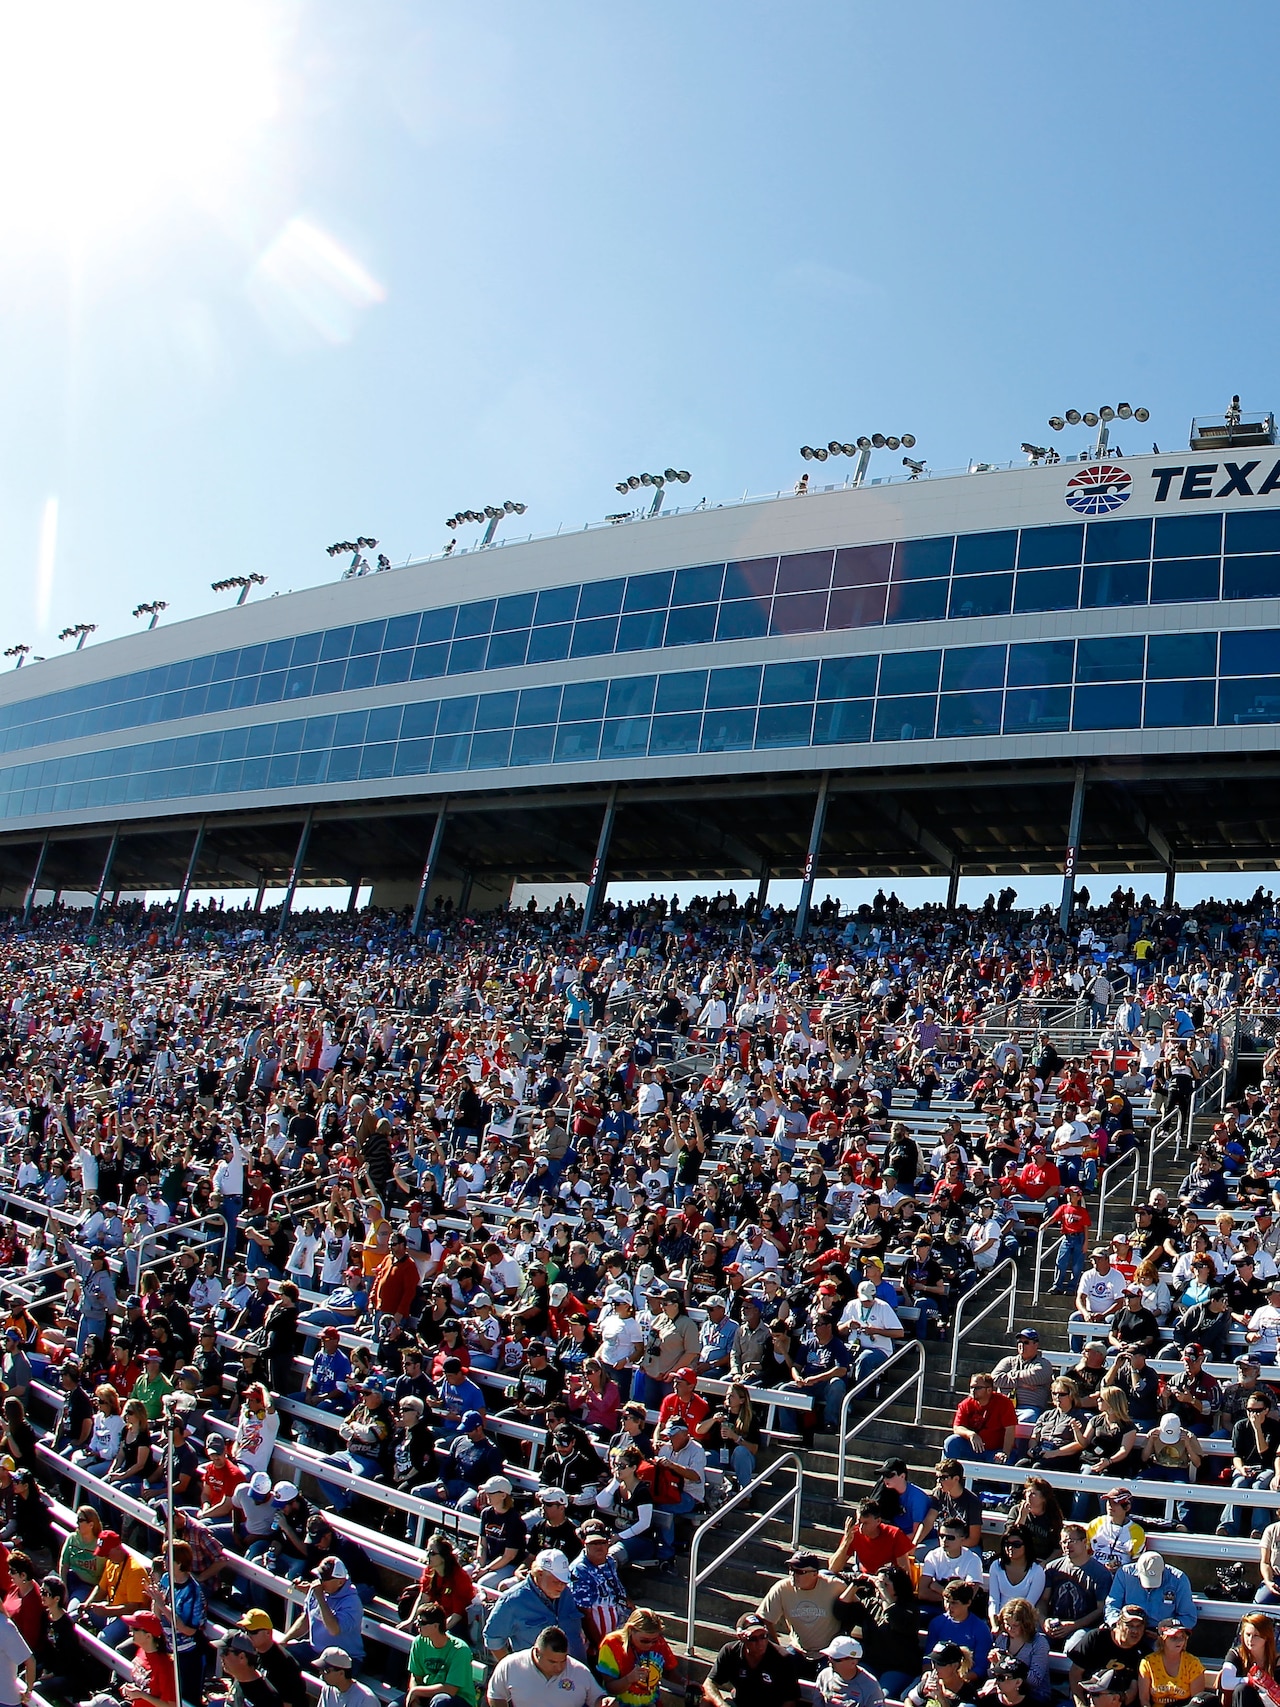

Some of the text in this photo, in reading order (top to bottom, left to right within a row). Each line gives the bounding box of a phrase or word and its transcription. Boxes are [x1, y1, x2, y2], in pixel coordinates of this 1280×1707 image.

[590, 858, 600, 884] 104
[804, 854, 813, 882] 103
[1065, 847, 1074, 877] 102
[421, 864, 430, 888] 105
[762, 1672, 772, 1683] 3
